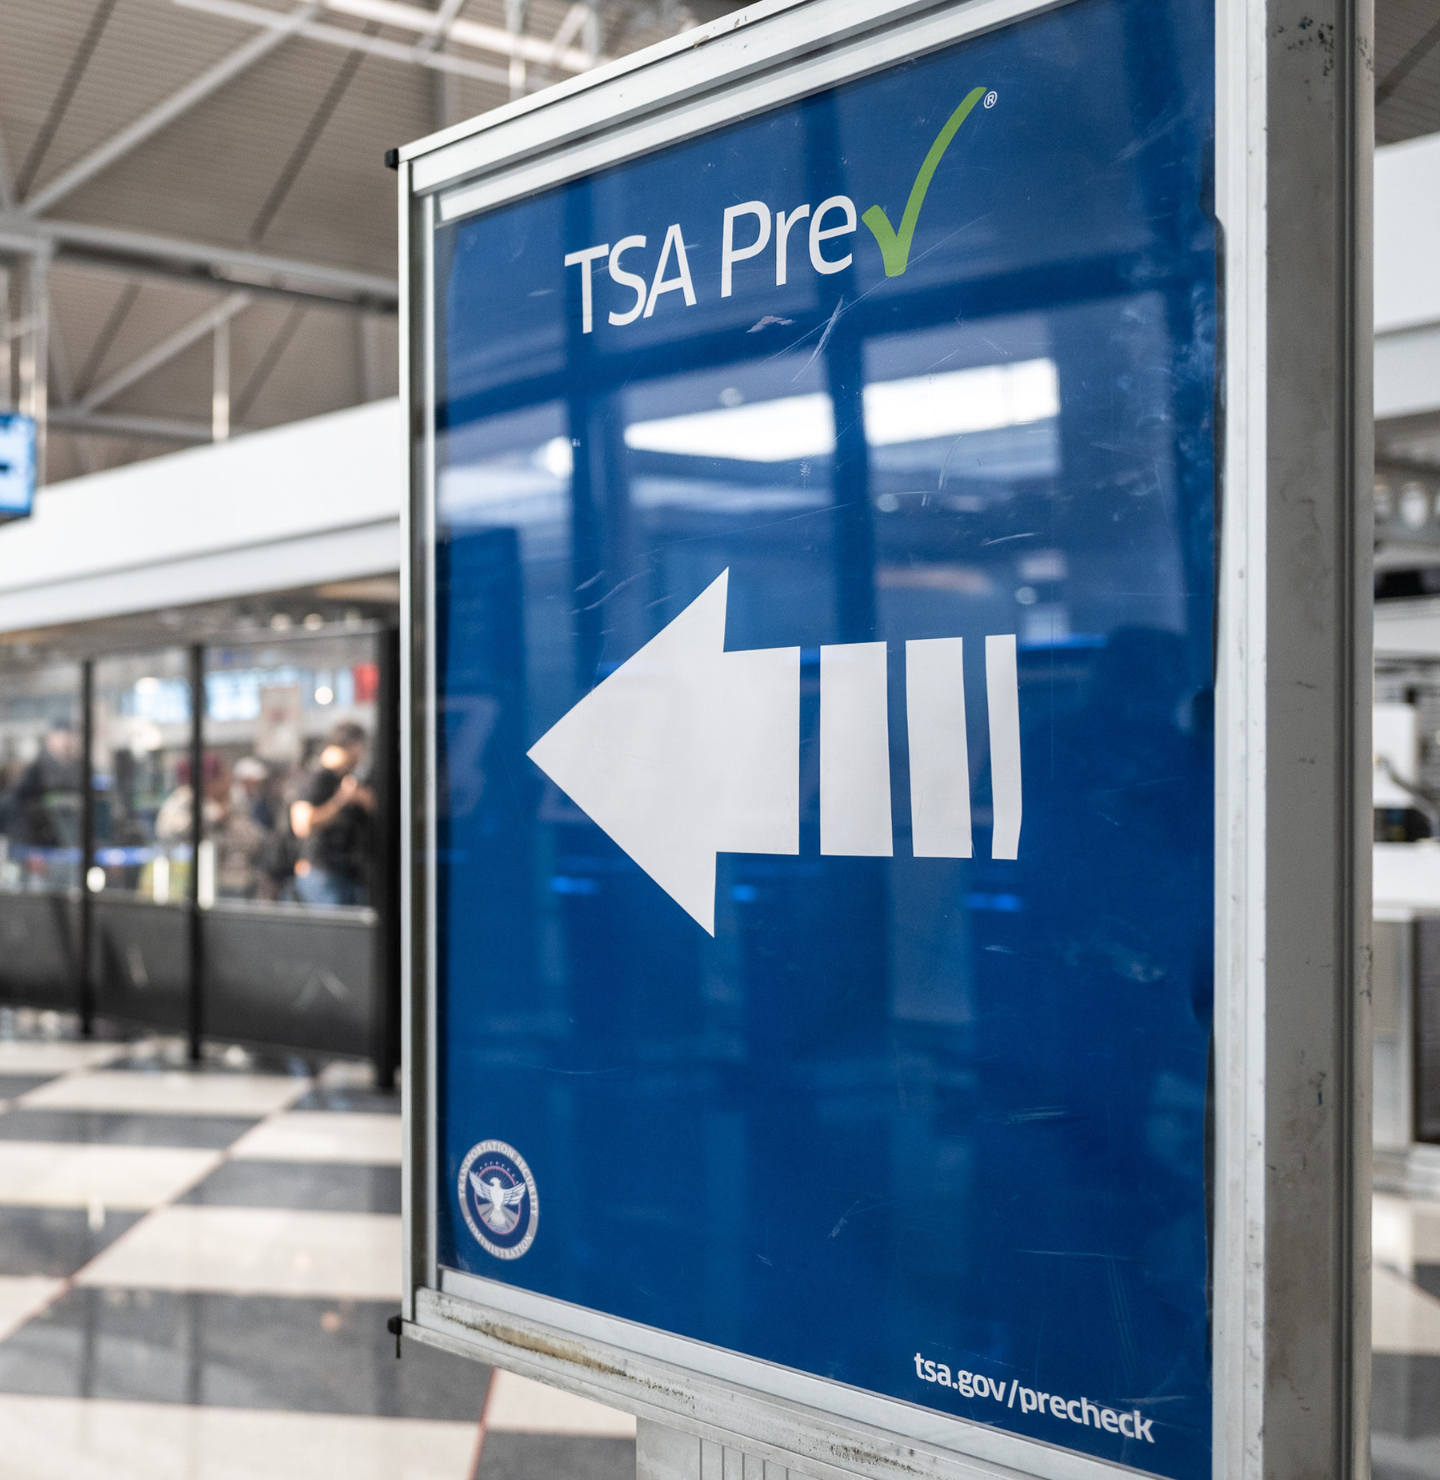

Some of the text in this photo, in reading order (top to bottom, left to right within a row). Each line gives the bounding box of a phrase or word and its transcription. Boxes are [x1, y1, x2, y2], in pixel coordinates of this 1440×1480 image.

[564, 223, 697, 334] TSA
[721, 195, 857, 298] Pre
[458, 1141, 538, 1216] TRANSPORTATION SECURITY
[465, 1216, 534, 1260] ADMINISTRATION
[914, 1352, 1155, 1443] tsa.gov/precheck
